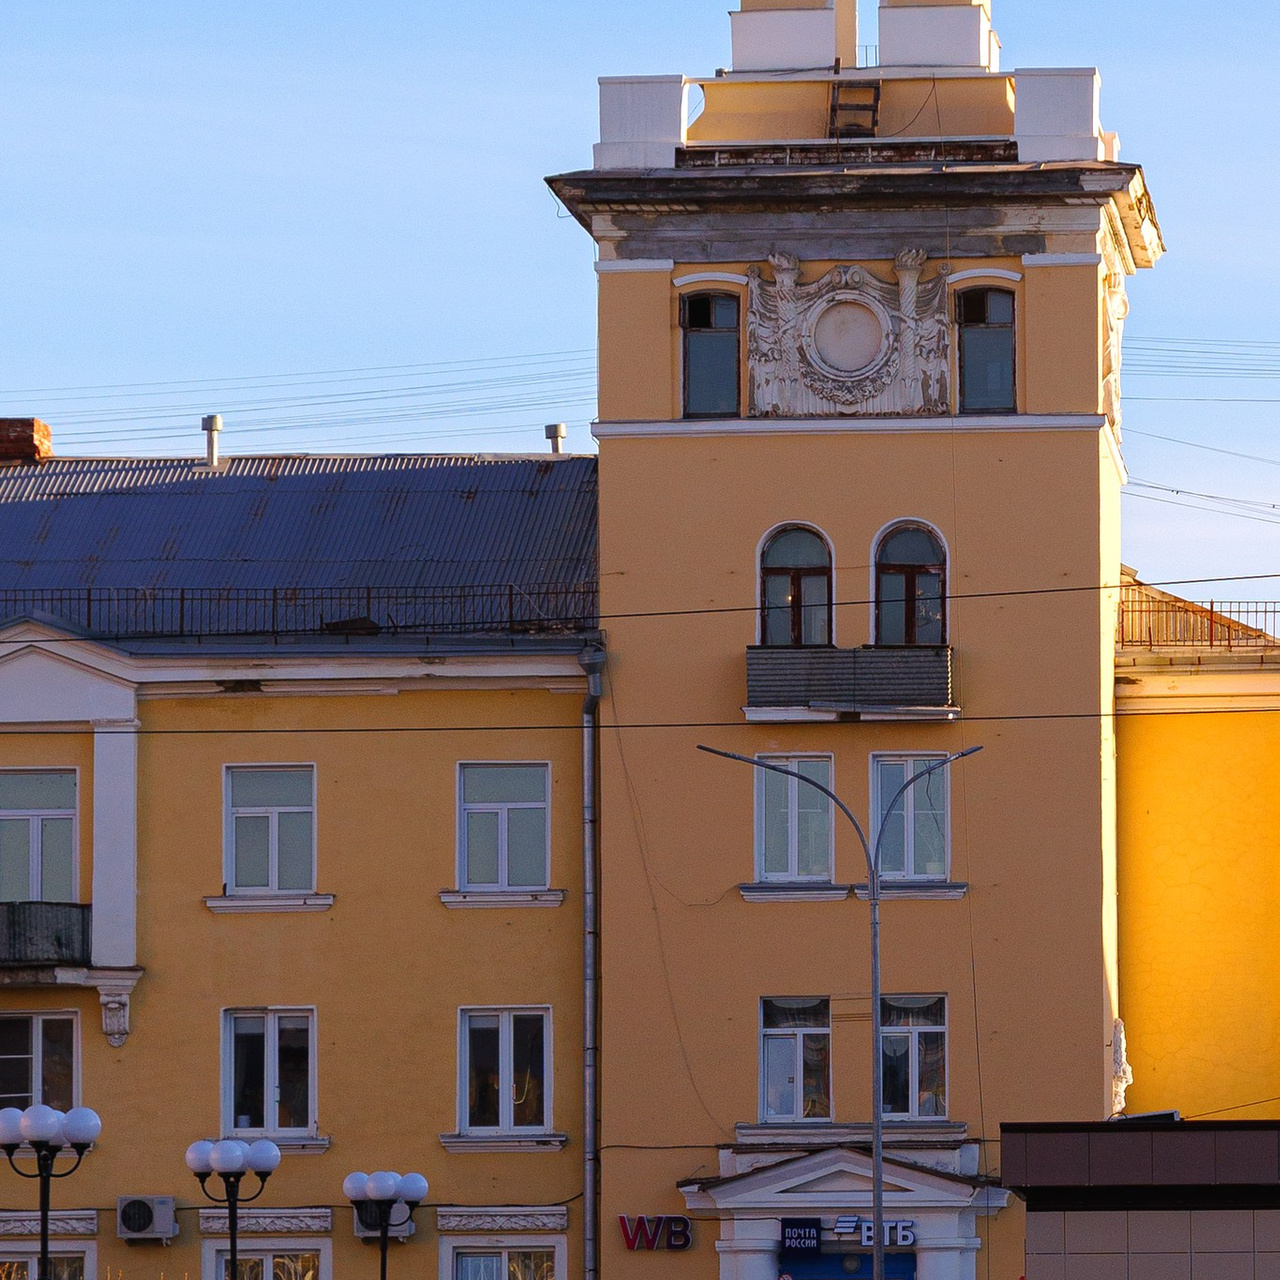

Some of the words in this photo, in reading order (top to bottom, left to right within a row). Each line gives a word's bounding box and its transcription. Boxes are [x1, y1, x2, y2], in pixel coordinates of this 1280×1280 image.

[618, 1214, 693, 1251] WB
[785, 1227, 817, 1238] ПОЧТА
[860, 1220, 916, 1247] ВТБ
[785, 1239, 817, 1248] РОССИИ
